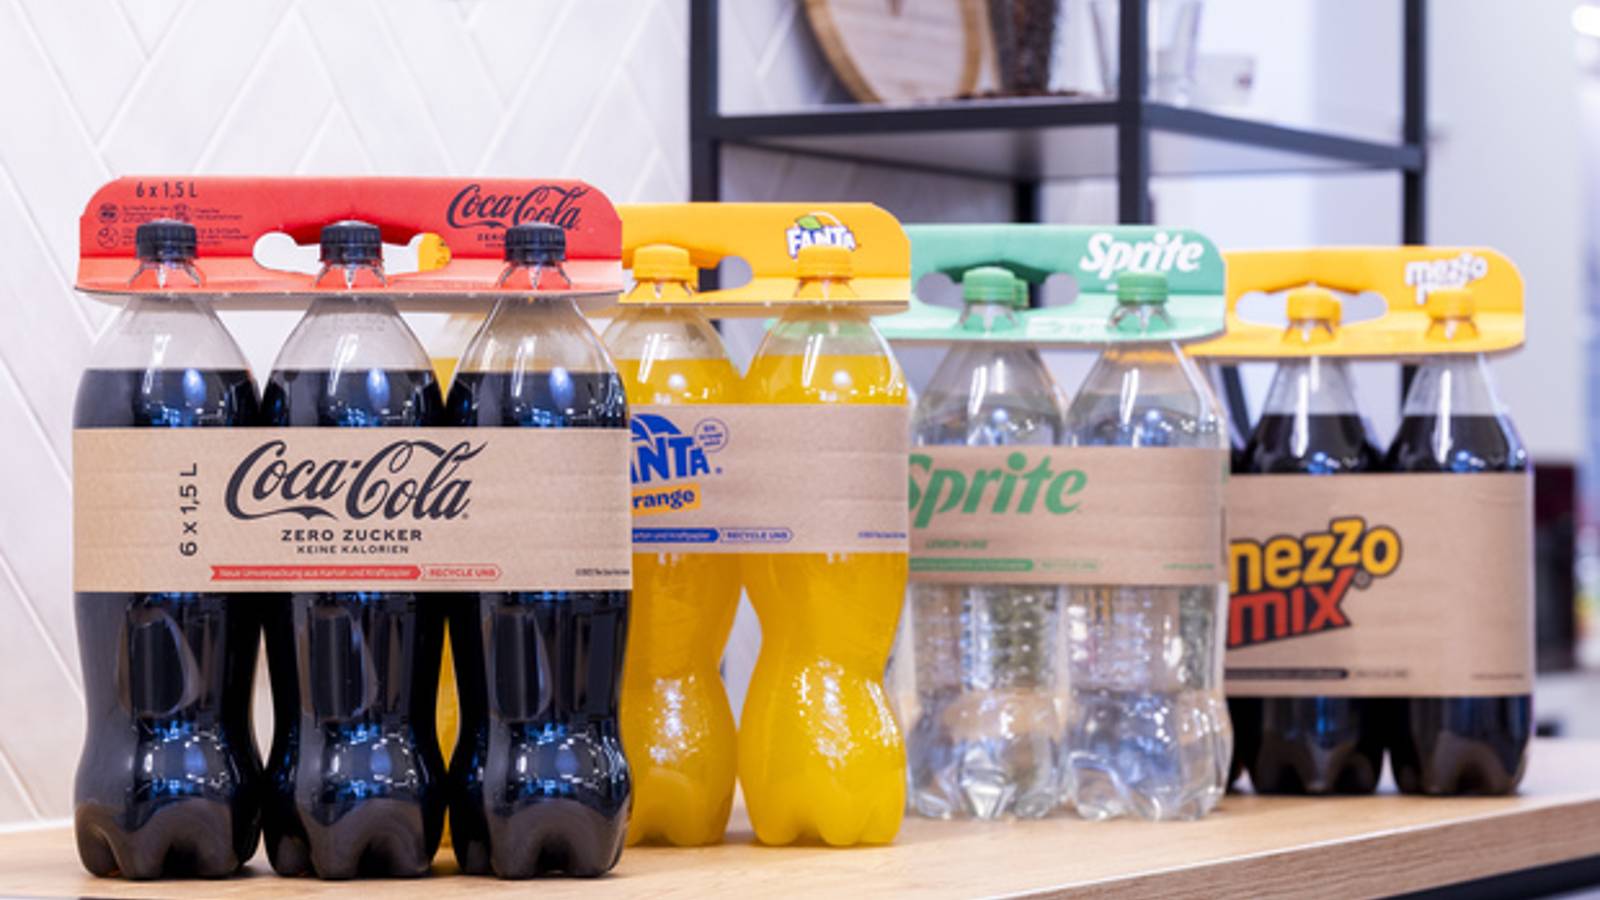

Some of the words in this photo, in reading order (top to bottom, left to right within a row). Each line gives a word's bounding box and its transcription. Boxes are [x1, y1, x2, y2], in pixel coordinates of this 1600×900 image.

[136, 181, 145, 198] 6
[149, 186, 158, 198] x
[189, 181, 198, 198] L
[1079, 231, 1204, 280] Sprite
[180, 463, 198, 477] L
[225, 439, 488, 520] Coca-Cola
[180, 484, 200, 513] 1,5
[631, 488, 696, 510] range
[183, 521, 197, 534] x
[281, 529, 334, 541] ZERO
[342, 529, 423, 541] ZUCKER
[180, 541, 198, 556] 6
[296, 545, 338, 554] KEINE
[340, 545, 409, 554] KALORIEN
[430, 568, 472, 577] RECYCLE
